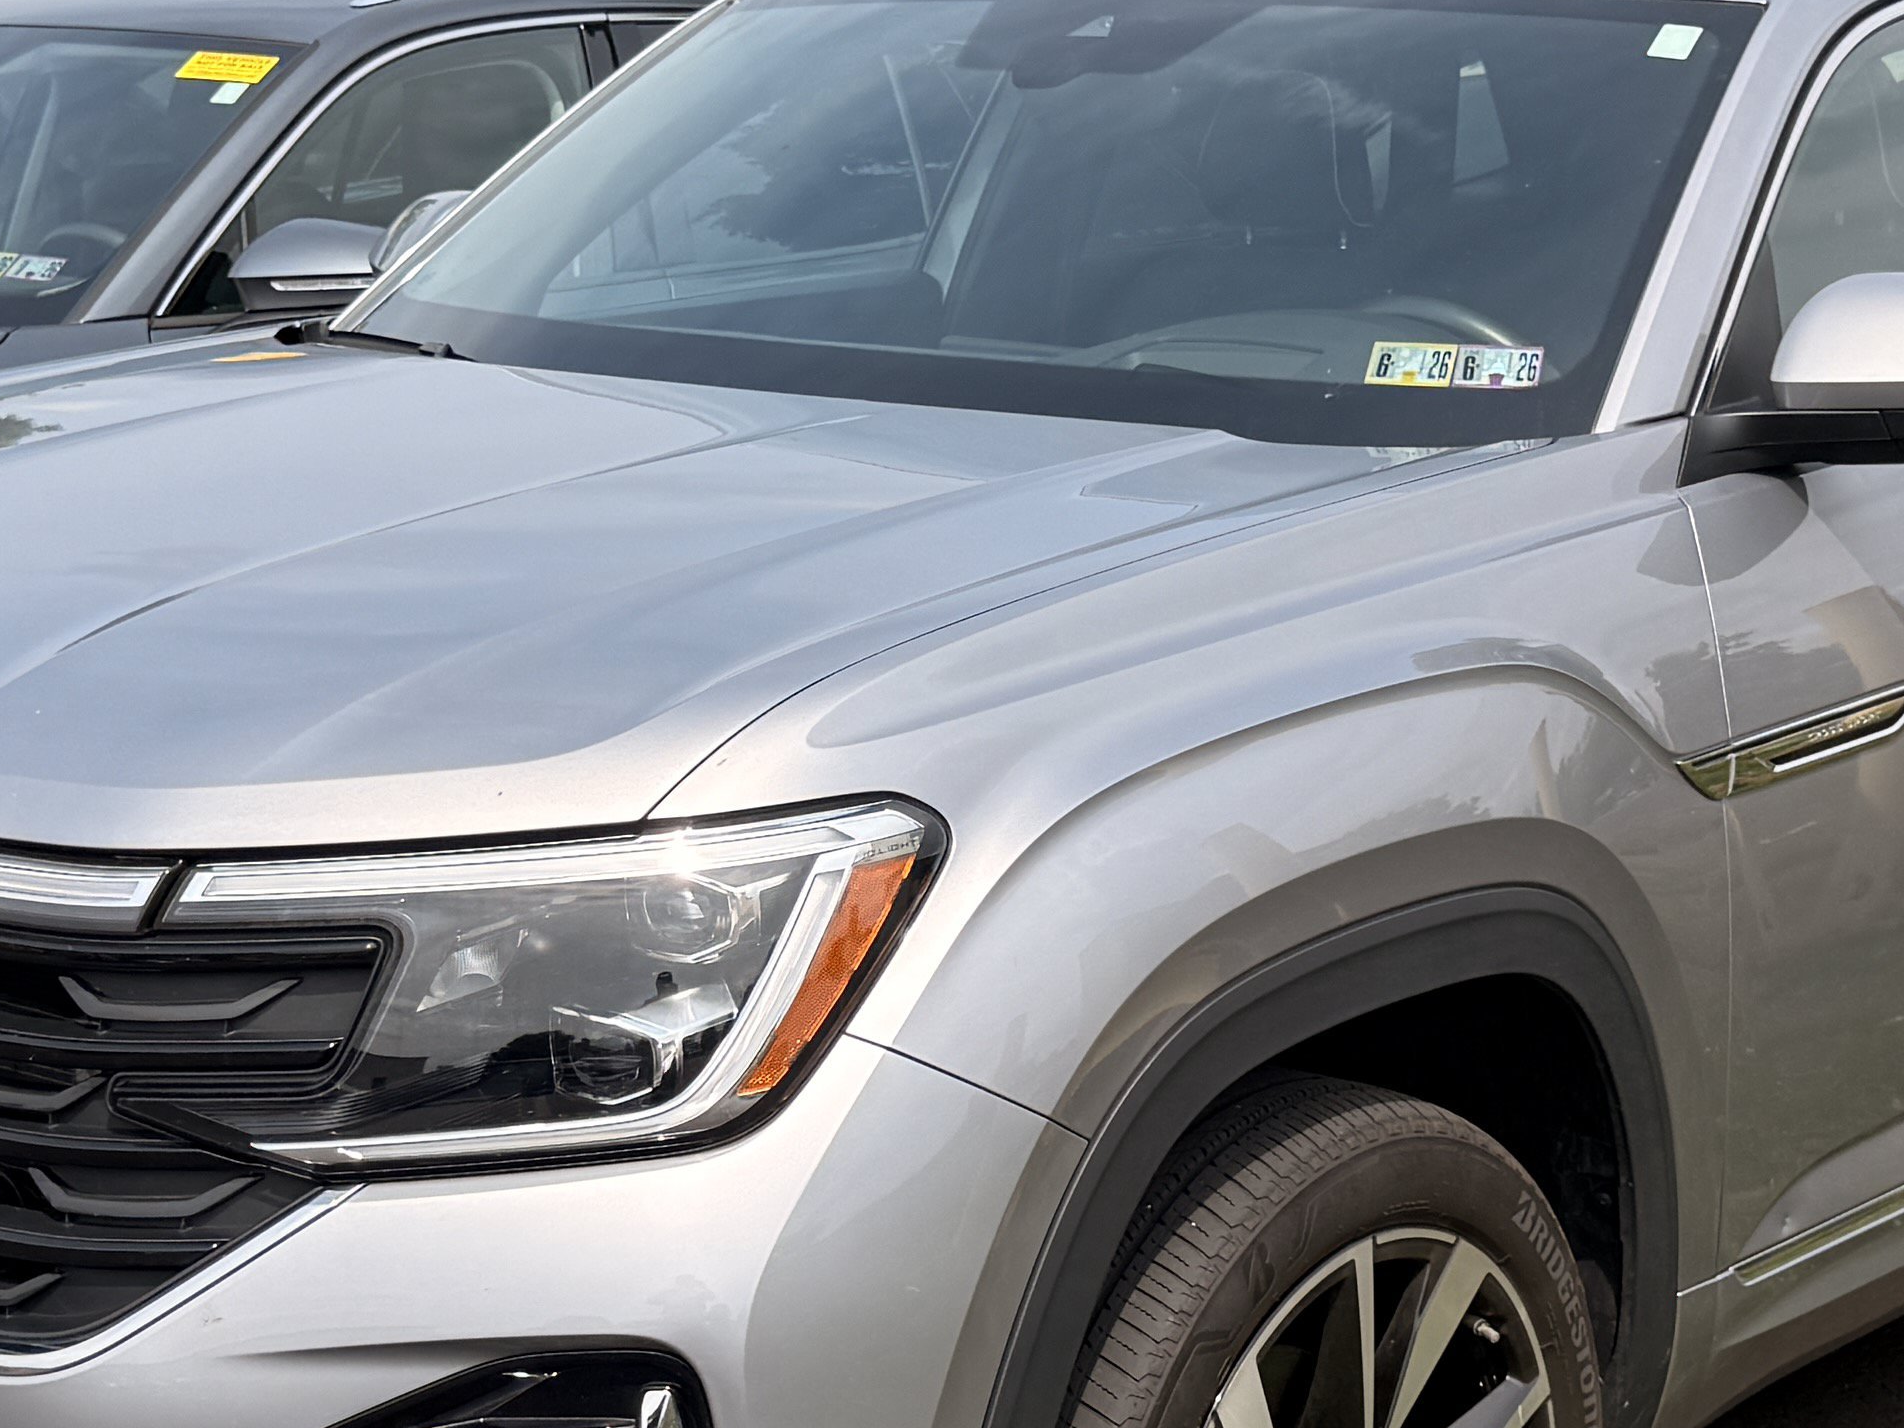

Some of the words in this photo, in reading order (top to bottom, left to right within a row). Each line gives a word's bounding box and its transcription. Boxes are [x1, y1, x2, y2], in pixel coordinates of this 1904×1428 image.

[1375, 352, 1392, 378] 6
[1427, 350, 1452, 381] 26
[1462, 355, 1477, 381] 6
[1515, 352, 1539, 382] 26
